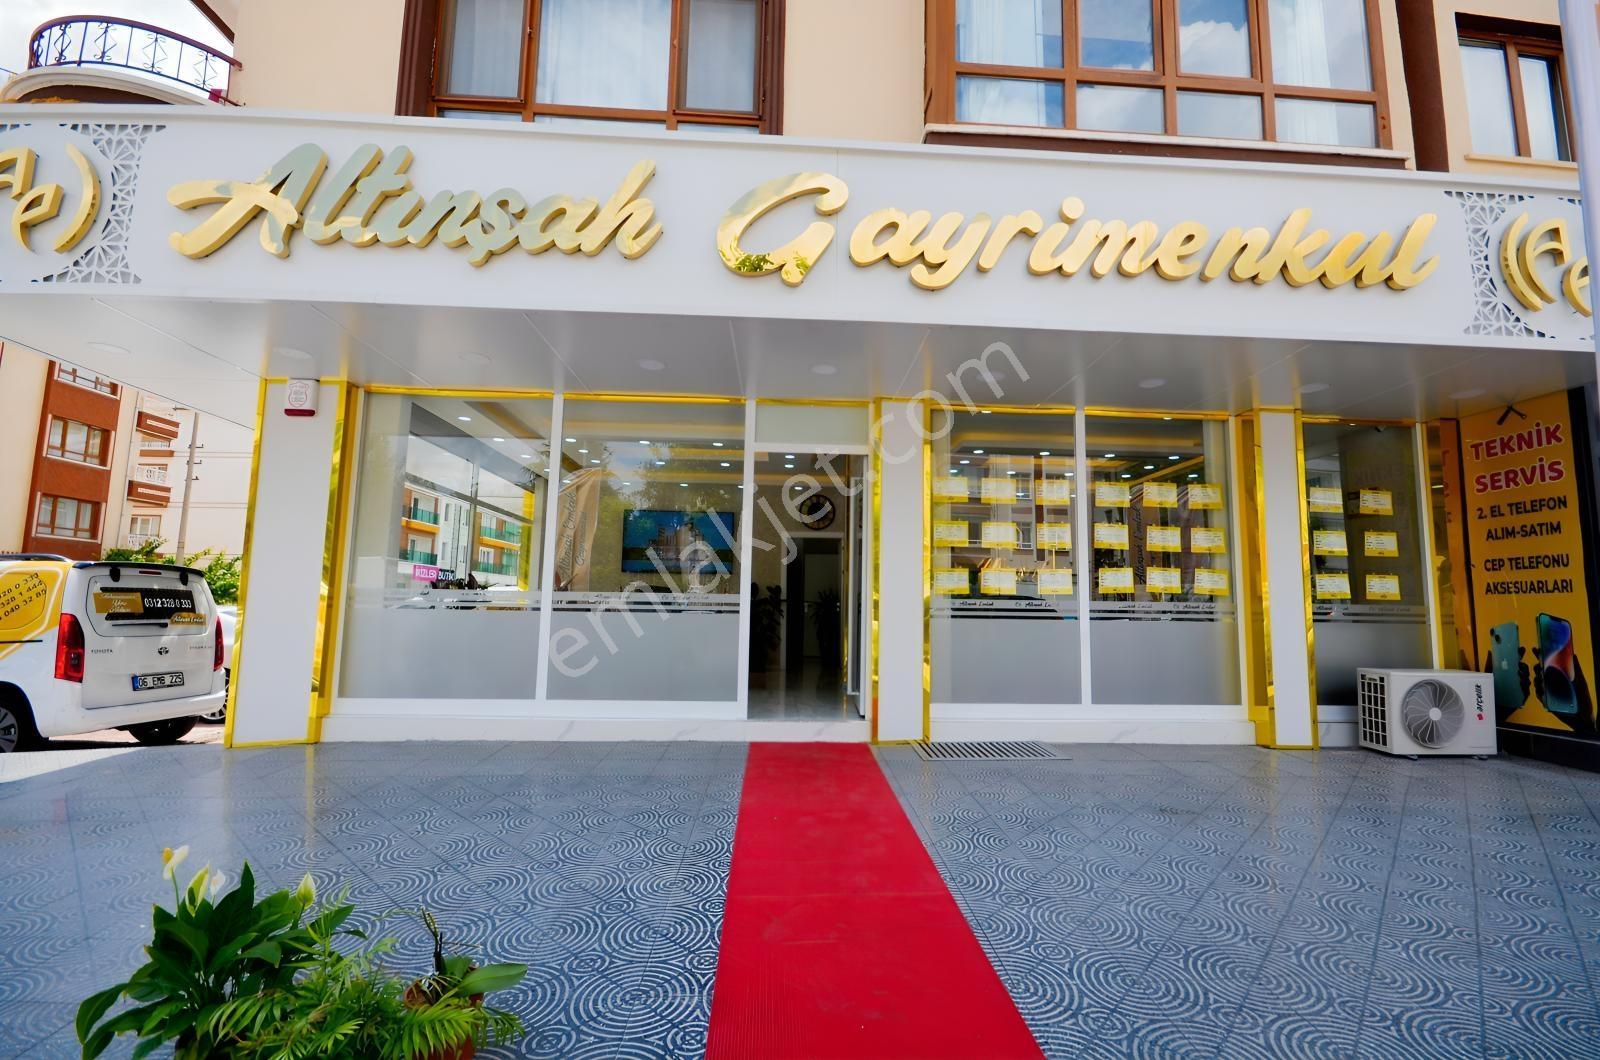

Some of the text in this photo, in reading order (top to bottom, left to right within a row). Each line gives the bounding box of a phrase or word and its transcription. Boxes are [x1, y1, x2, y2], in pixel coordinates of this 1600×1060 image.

[166, 142, 1440, 290] Altınşah Gayrimenkul
[1469, 421, 1565, 461] TEKNİK
[1474, 455, 1565, 494] SERVİS
[1476, 495, 1568, 520] 2. EL TELEFON
[1485, 521, 1562, 542] ALIM-SATIM
[1483, 553, 1570, 572] CEP TELEFONU
[1484, 578, 1574, 595] AKSESUARLARI
[144, 598, 161, 608] 0312
[181, 599, 192, 608] 333
[138, 677, 148, 687] 06
